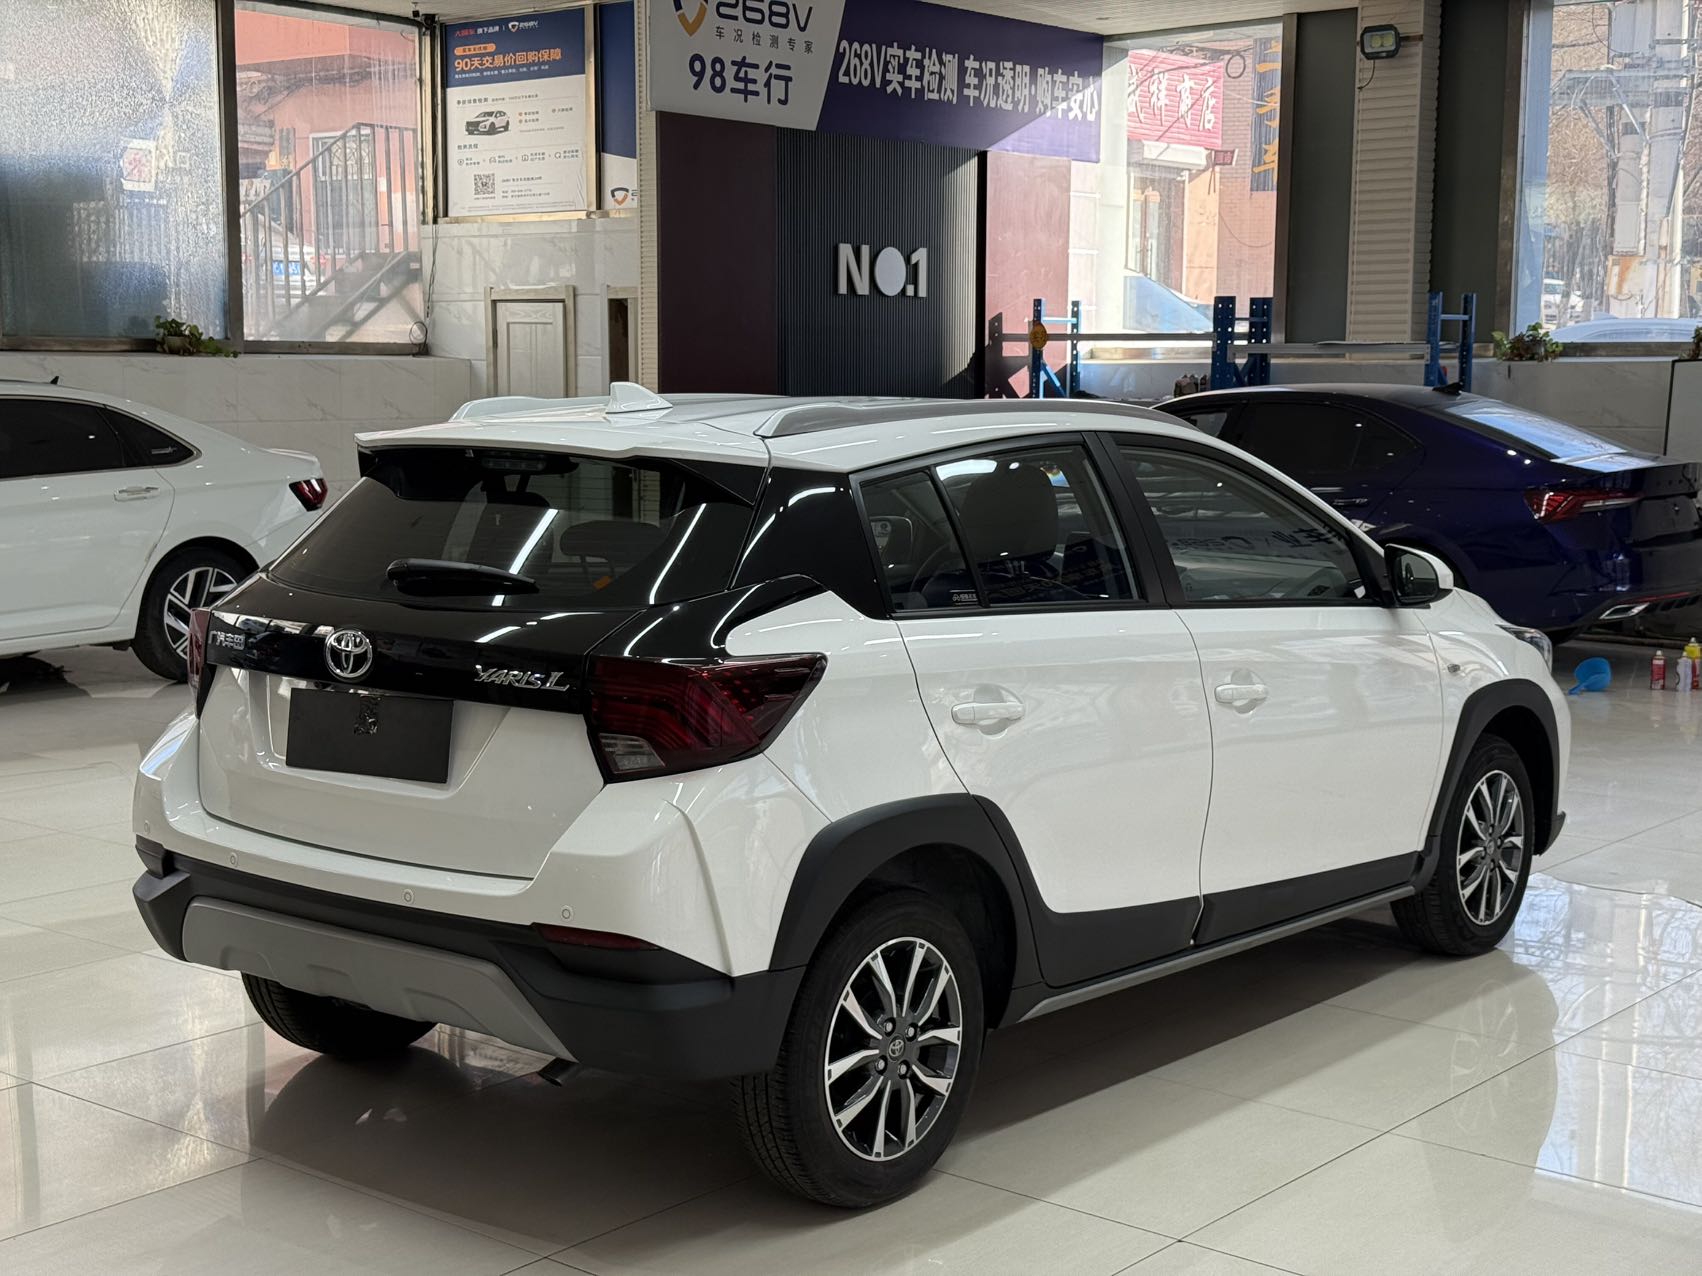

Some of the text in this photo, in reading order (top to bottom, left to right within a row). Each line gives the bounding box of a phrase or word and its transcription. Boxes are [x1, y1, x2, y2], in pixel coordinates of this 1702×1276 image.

[715, 0, 813, 32] 268V
[715, 25, 814, 55] 车况检测专家
[454, 48, 562, 72] 90天交易价回购保障
[838, 39, 958, 105] 268V实车检测
[688, 53, 793, 105] 98车行
[838, 243, 927, 298] NO.1
[474, 665, 570, 692] YARIS L
